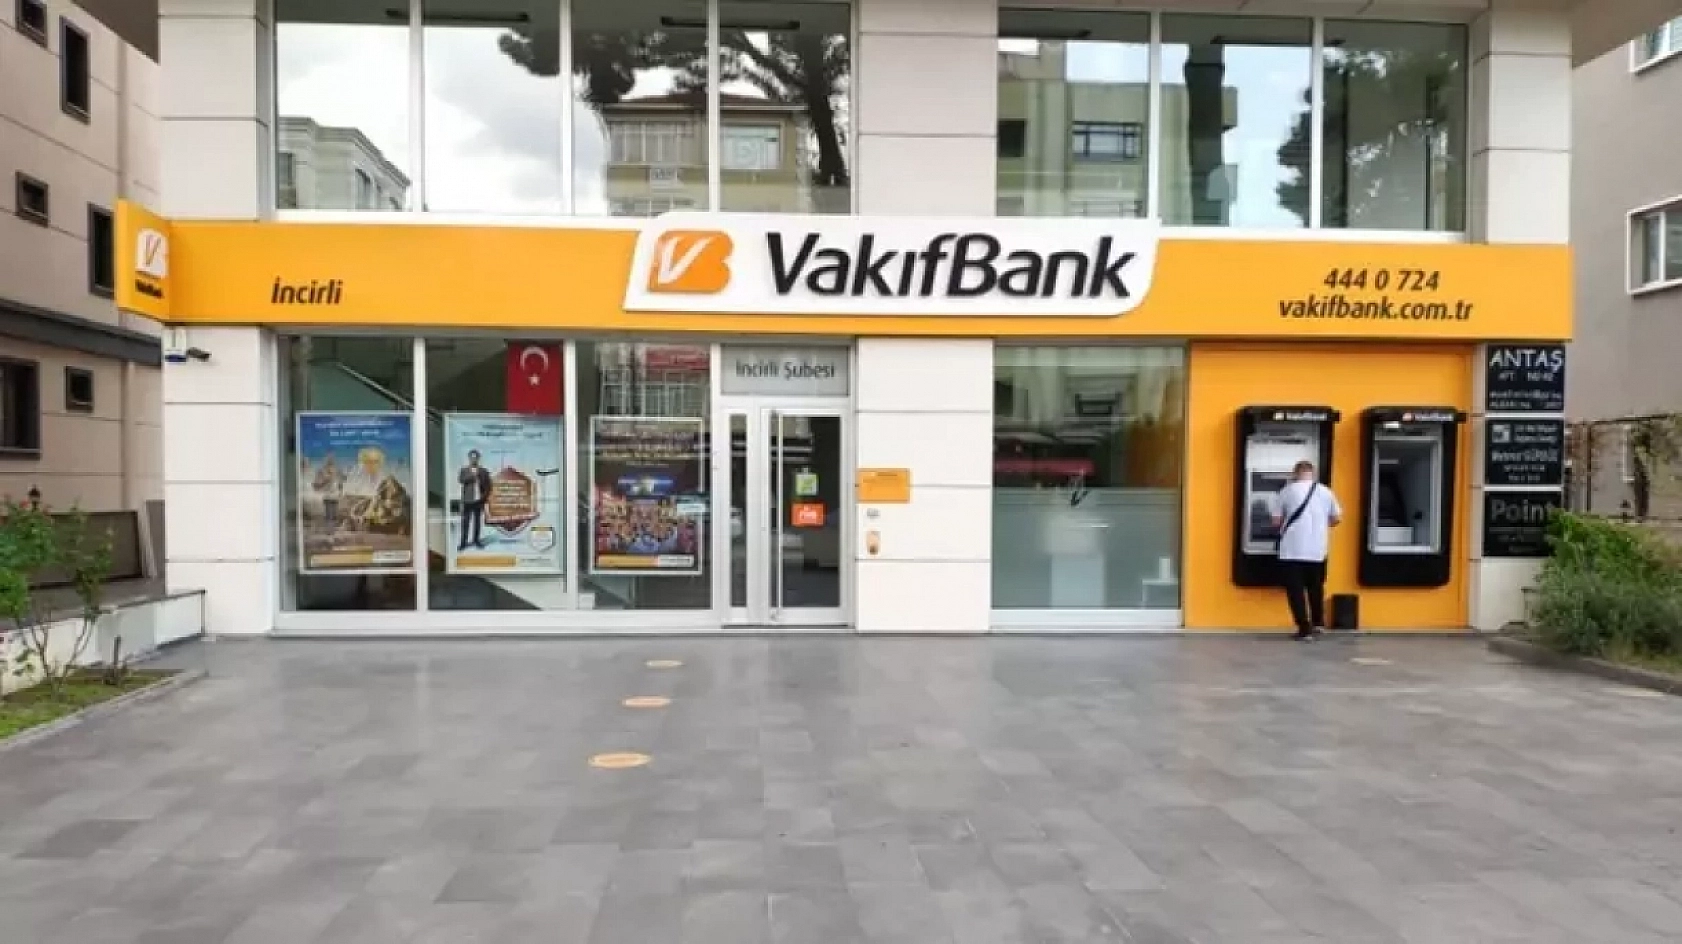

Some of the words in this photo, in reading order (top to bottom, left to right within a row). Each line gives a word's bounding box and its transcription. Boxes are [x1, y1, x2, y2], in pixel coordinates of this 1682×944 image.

[765, 231, 1137, 298] VakıfBank
[271, 275, 344, 305] İncirli
[1323, 267, 1368, 290] 444
[1374, 268, 1390, 291] 0
[1397, 270, 1441, 292] 724
[1279, 295, 1474, 321] vakifbank.com.tr
[784, 360, 835, 381] Şubesi
[1489, 348, 1562, 373] ANTAŞ
